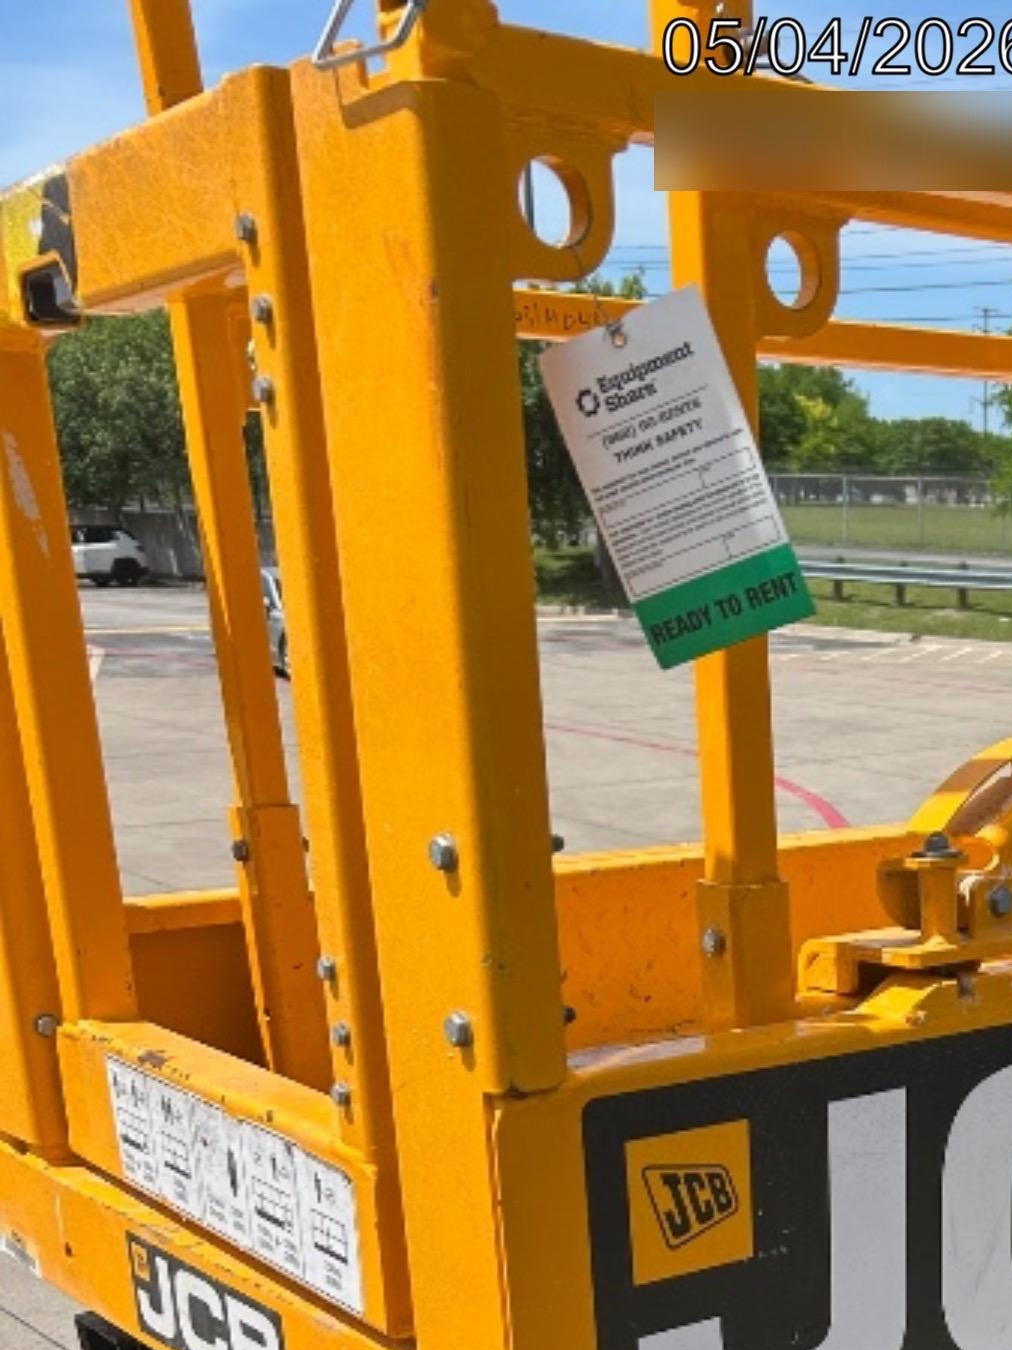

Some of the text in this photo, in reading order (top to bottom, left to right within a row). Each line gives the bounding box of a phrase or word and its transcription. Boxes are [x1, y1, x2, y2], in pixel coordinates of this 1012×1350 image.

[597, 341, 694, 394] Equipment
[604, 380, 657, 413] Share
[650, 572, 799, 646] READY TO RENT
[659, 1172, 733, 1239] JCB
